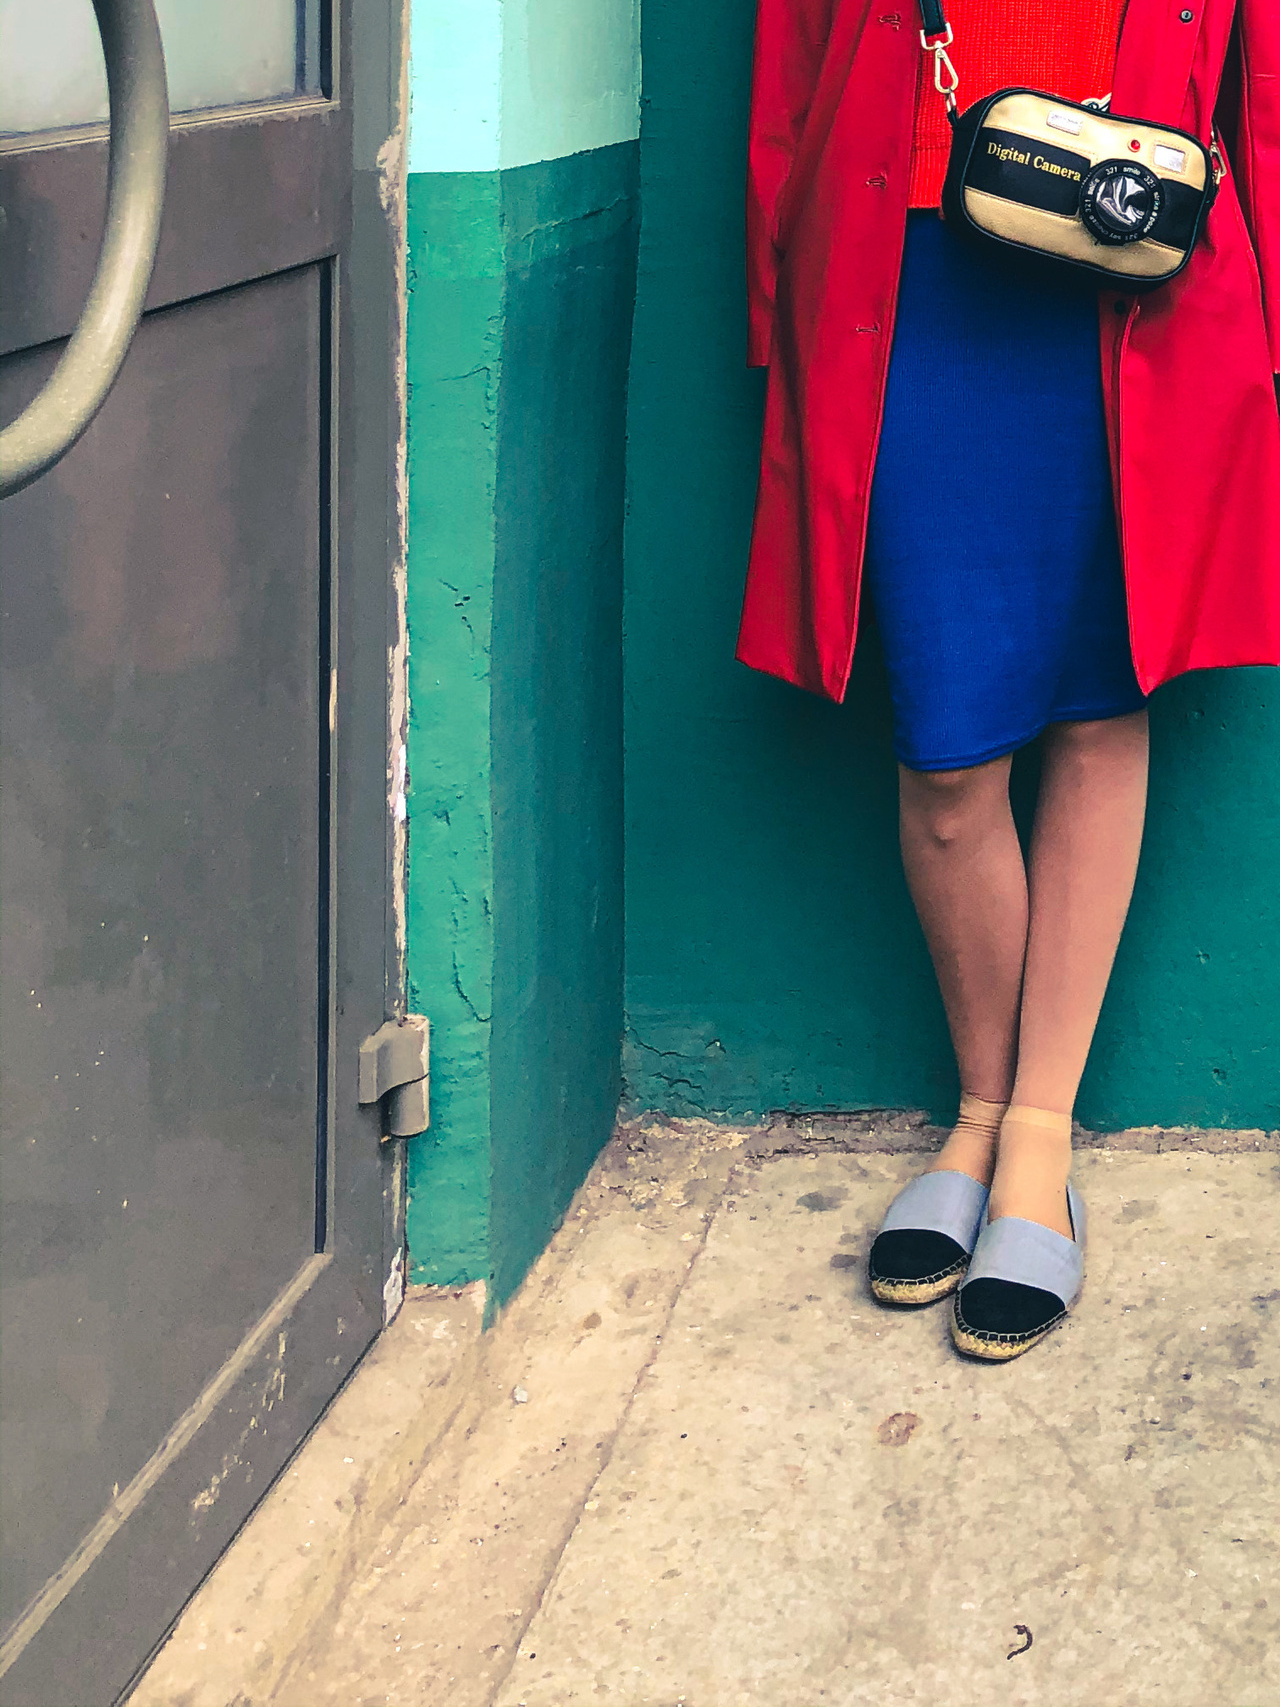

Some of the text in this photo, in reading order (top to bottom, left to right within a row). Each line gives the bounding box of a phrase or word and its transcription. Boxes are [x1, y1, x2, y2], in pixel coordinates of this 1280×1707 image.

[987, 142, 1031, 165] Digital
[1033, 155, 1081, 182] Camera
[1105, 166, 1118, 175] 321
[1143, 175, 1156, 188] 321
